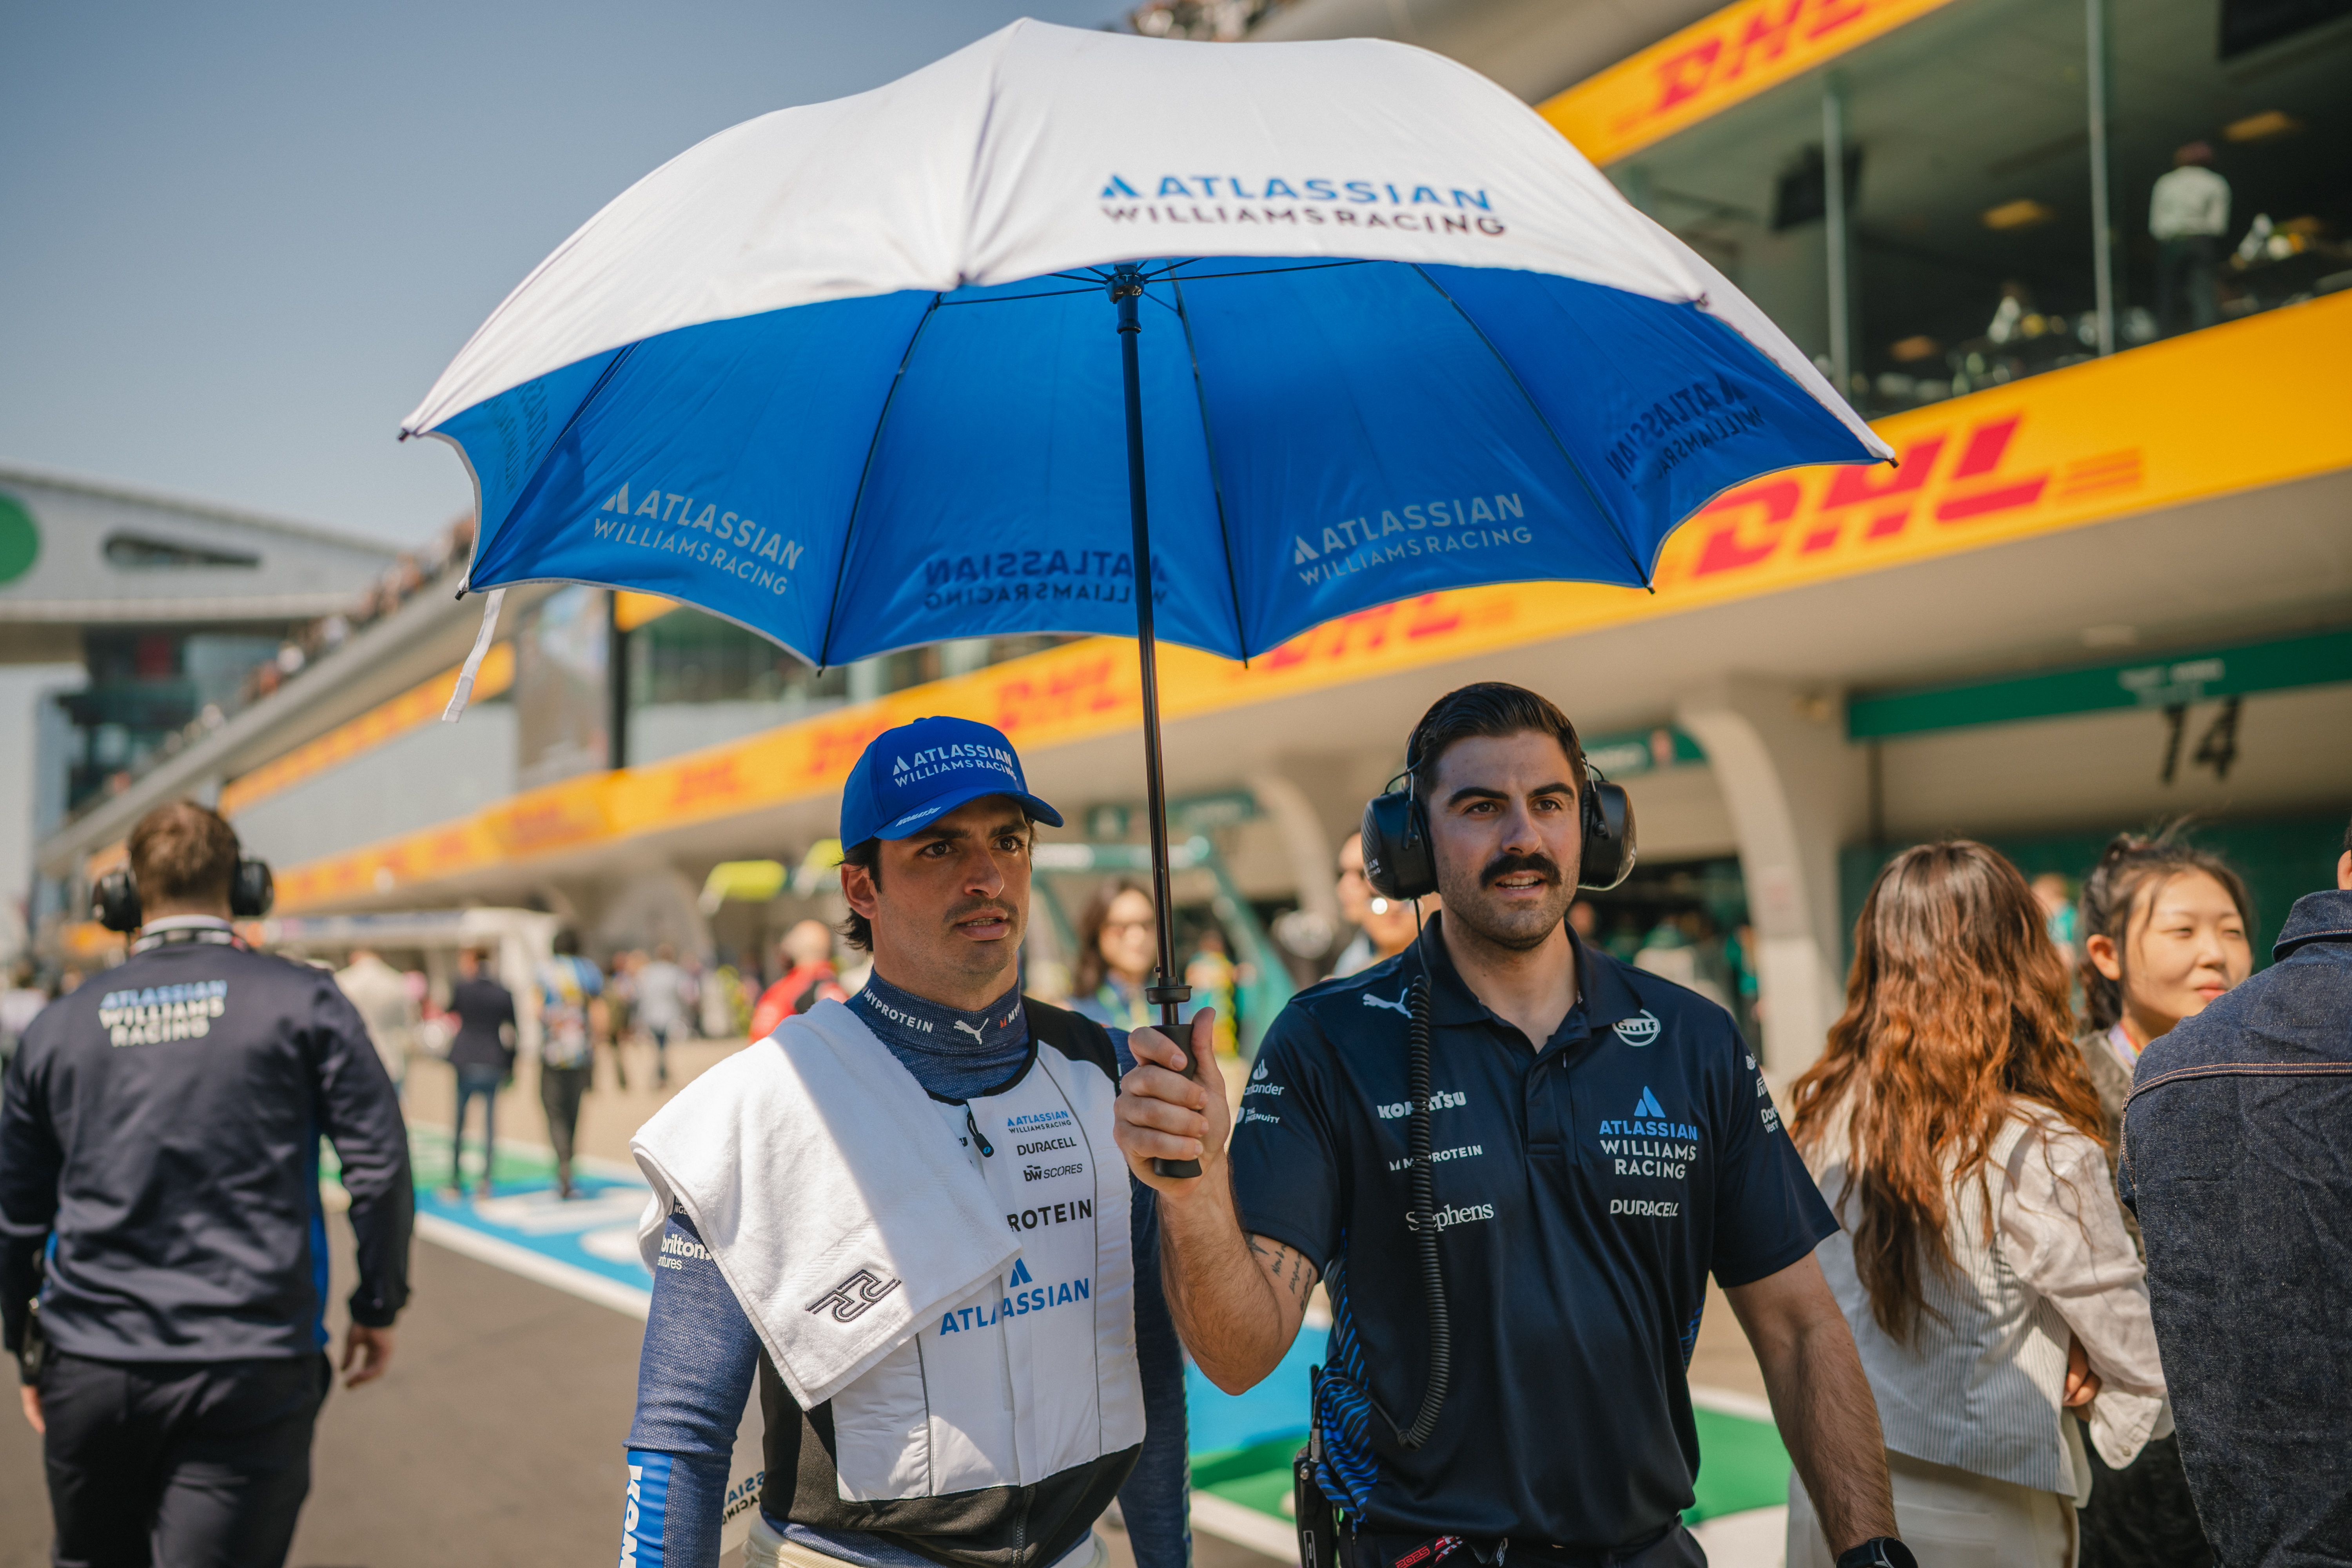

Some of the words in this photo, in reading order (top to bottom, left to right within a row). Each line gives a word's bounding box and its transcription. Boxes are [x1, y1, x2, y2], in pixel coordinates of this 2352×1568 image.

[1157, 175, 1493, 211] ATLASSIAN
[1693, 410, 2050, 578] DHL
[635, 490, 804, 570] ATLASSIAN
[1323, 494, 1524, 554] ATLASSIAN
[914, 744, 1013, 767] ATLASSIAN
[2162, 697, 2243, 785] 14
[895, 806, 941, 827] KOMATSU
[98, 996, 225, 1029] WILLIAMS
[864, 989, 933, 1033] MYPROTEIN
[1615, 1019, 1655, 1032] Gulf
[110, 1016, 210, 1047] RACING
[1016, 1111, 1068, 1125] ATLASSIAN
[1599, 1120, 1698, 1141] ATLASSIAN
[1017, 1137, 1076, 1156] DURACELL
[1600, 1140, 1696, 1161] WILLIAMS
[1615, 1159, 1686, 1180] RACING
[1007, 1199, 1092, 1232] ROTEIN
[1406, 1203, 1494, 1231] Sphens
[1610, 1200, 1679, 1217] DURACELL
[940, 1278, 1089, 1335] ATLASSIAN
